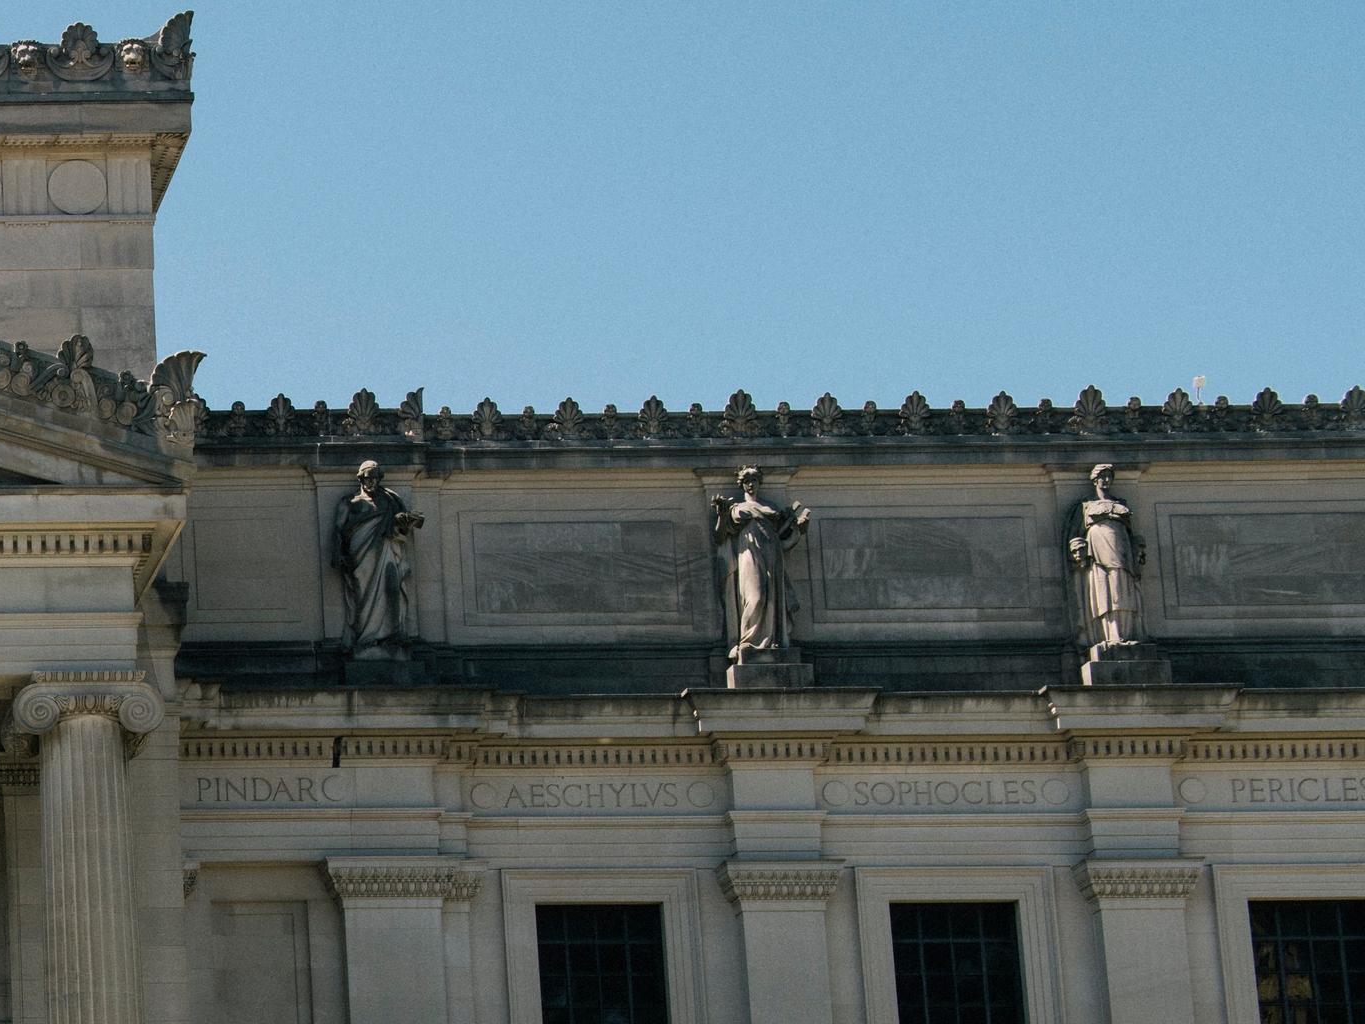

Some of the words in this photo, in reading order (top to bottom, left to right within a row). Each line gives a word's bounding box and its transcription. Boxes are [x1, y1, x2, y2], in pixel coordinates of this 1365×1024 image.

[197, 777, 318, 802] PINDAR
[504, 783, 678, 809] AESCHYLVS
[854, 779, 1037, 806] SOPHOCLES
